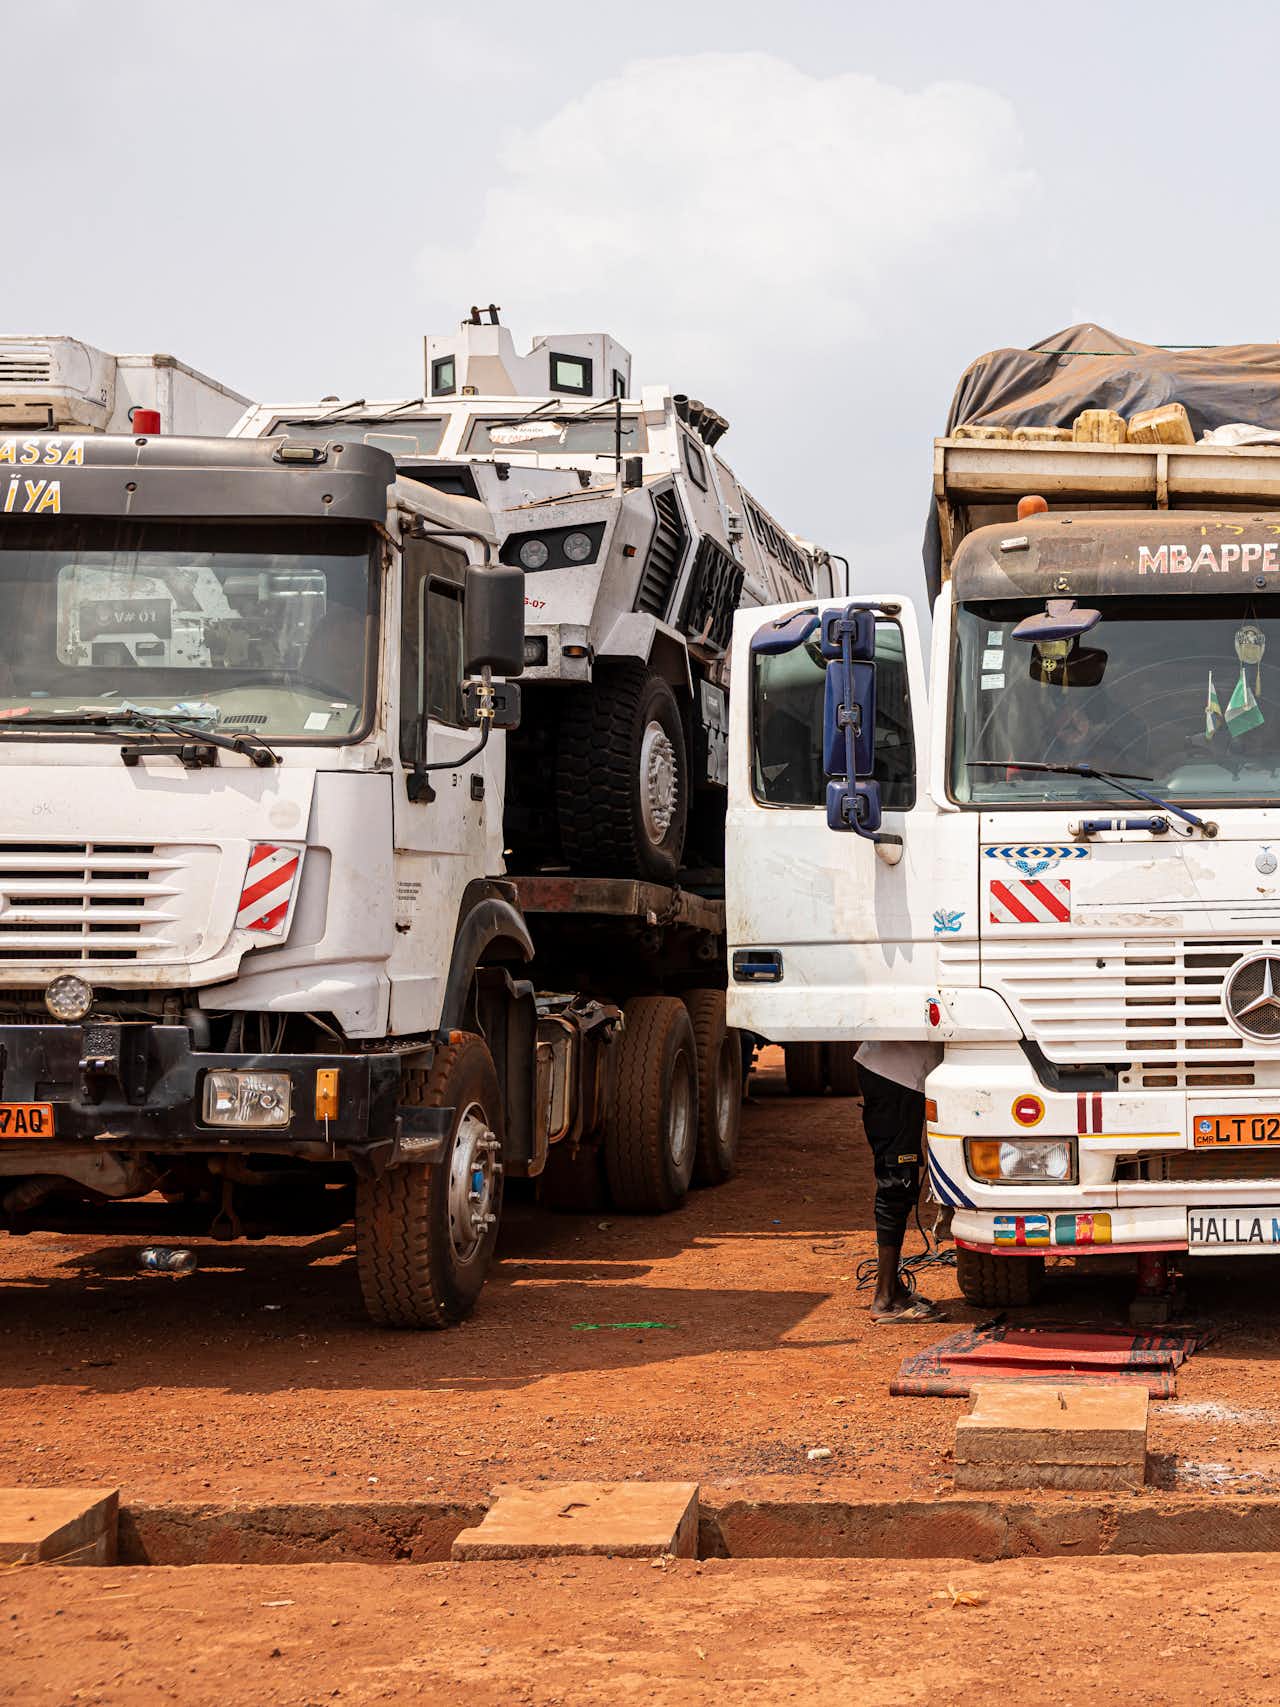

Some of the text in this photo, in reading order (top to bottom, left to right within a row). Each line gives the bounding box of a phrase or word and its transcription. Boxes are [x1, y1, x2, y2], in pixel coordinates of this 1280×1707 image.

[1196, 1135, 1214, 1144] CMR
[1215, 1119, 1246, 1142] LT
[1190, 1217, 1264, 1243] HALLA
